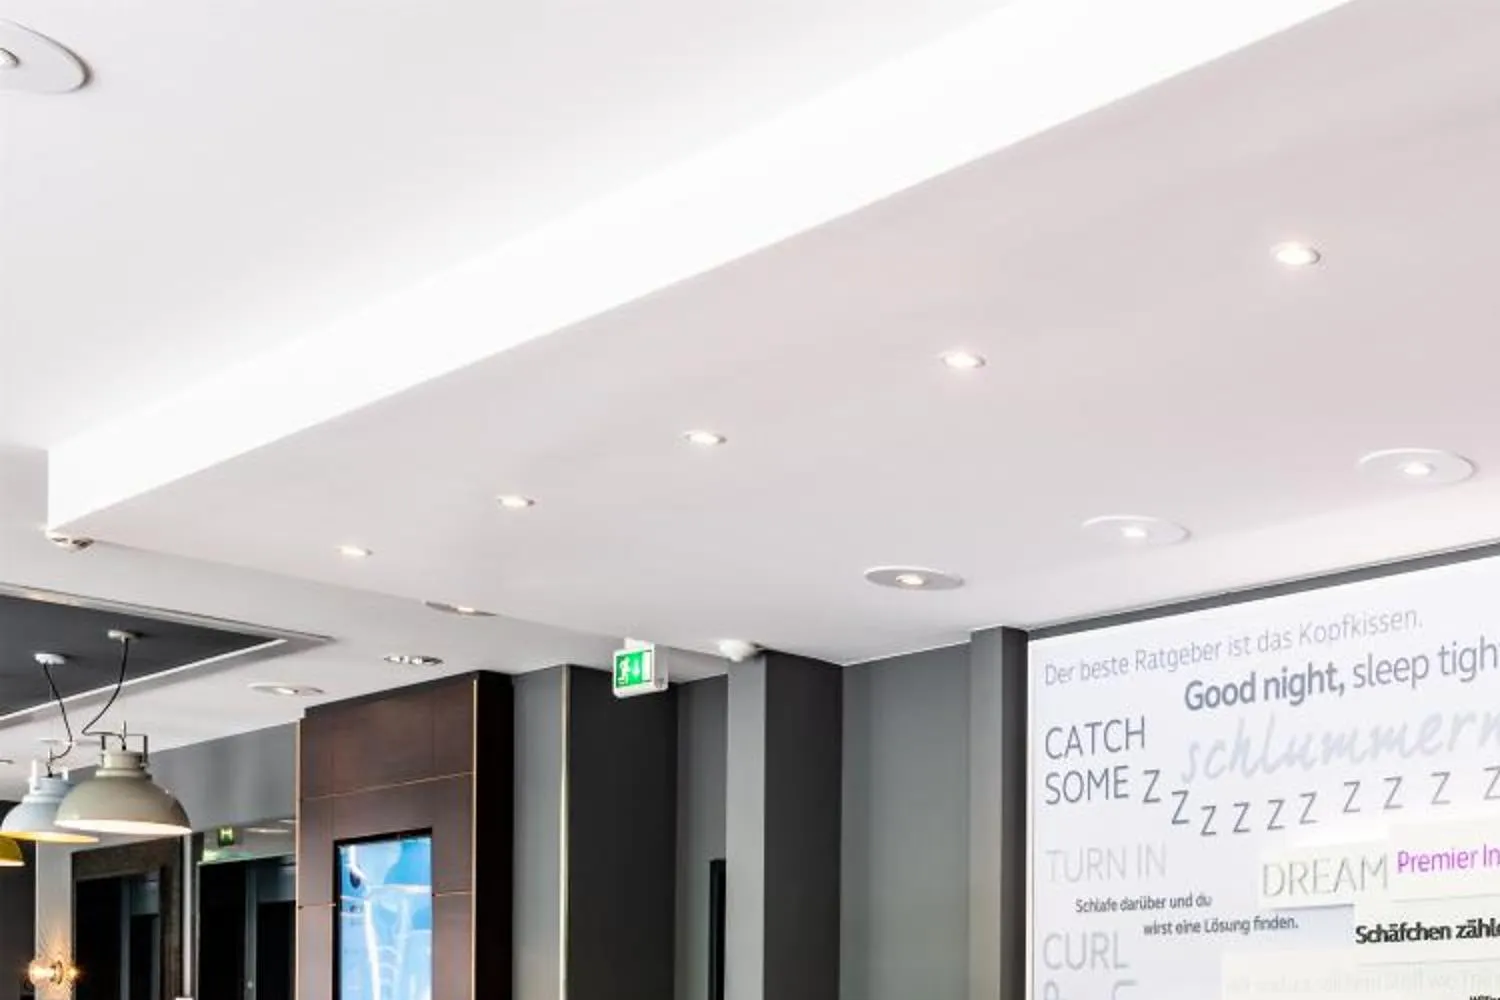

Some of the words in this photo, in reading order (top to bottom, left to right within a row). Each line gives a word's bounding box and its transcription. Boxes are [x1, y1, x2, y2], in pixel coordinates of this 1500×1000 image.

[1045, 663, 1073, 686] Der
[1080, 656, 1128, 679] beste
[1135, 642, 1221, 673] Ratgeber
[1228, 636, 1252, 657] ist
[1258, 629, 1291, 651] das
[1299, 609, 1423, 646] Kopfkissen.
[1185, 673, 1255, 709] Good
[1263, 662, 1345, 705] night,
[1353, 652, 1428, 689] sleep
[1045, 716, 1145, 760] CATCH
[1045, 766, 1129, 805] SOME
[1046, 847, 1126, 882] TURN
[1137, 843, 1167, 879] IN
[1262, 855, 1388, 897] DREAM
[1397, 848, 1477, 874] Premier
[1120, 894, 1166, 912] darüber
[1170, 893, 1192, 909] und
[1196, 893, 1212, 908] du
[1143, 919, 1172, 936] wirst
[1175, 920, 1200, 934] eine
[1204, 916, 1250, 936] Lösung
[1254, 915, 1298, 931] finden.
[1355, 918, 1450, 945] Schäfchen
[1043, 930, 1128, 970] CURL
